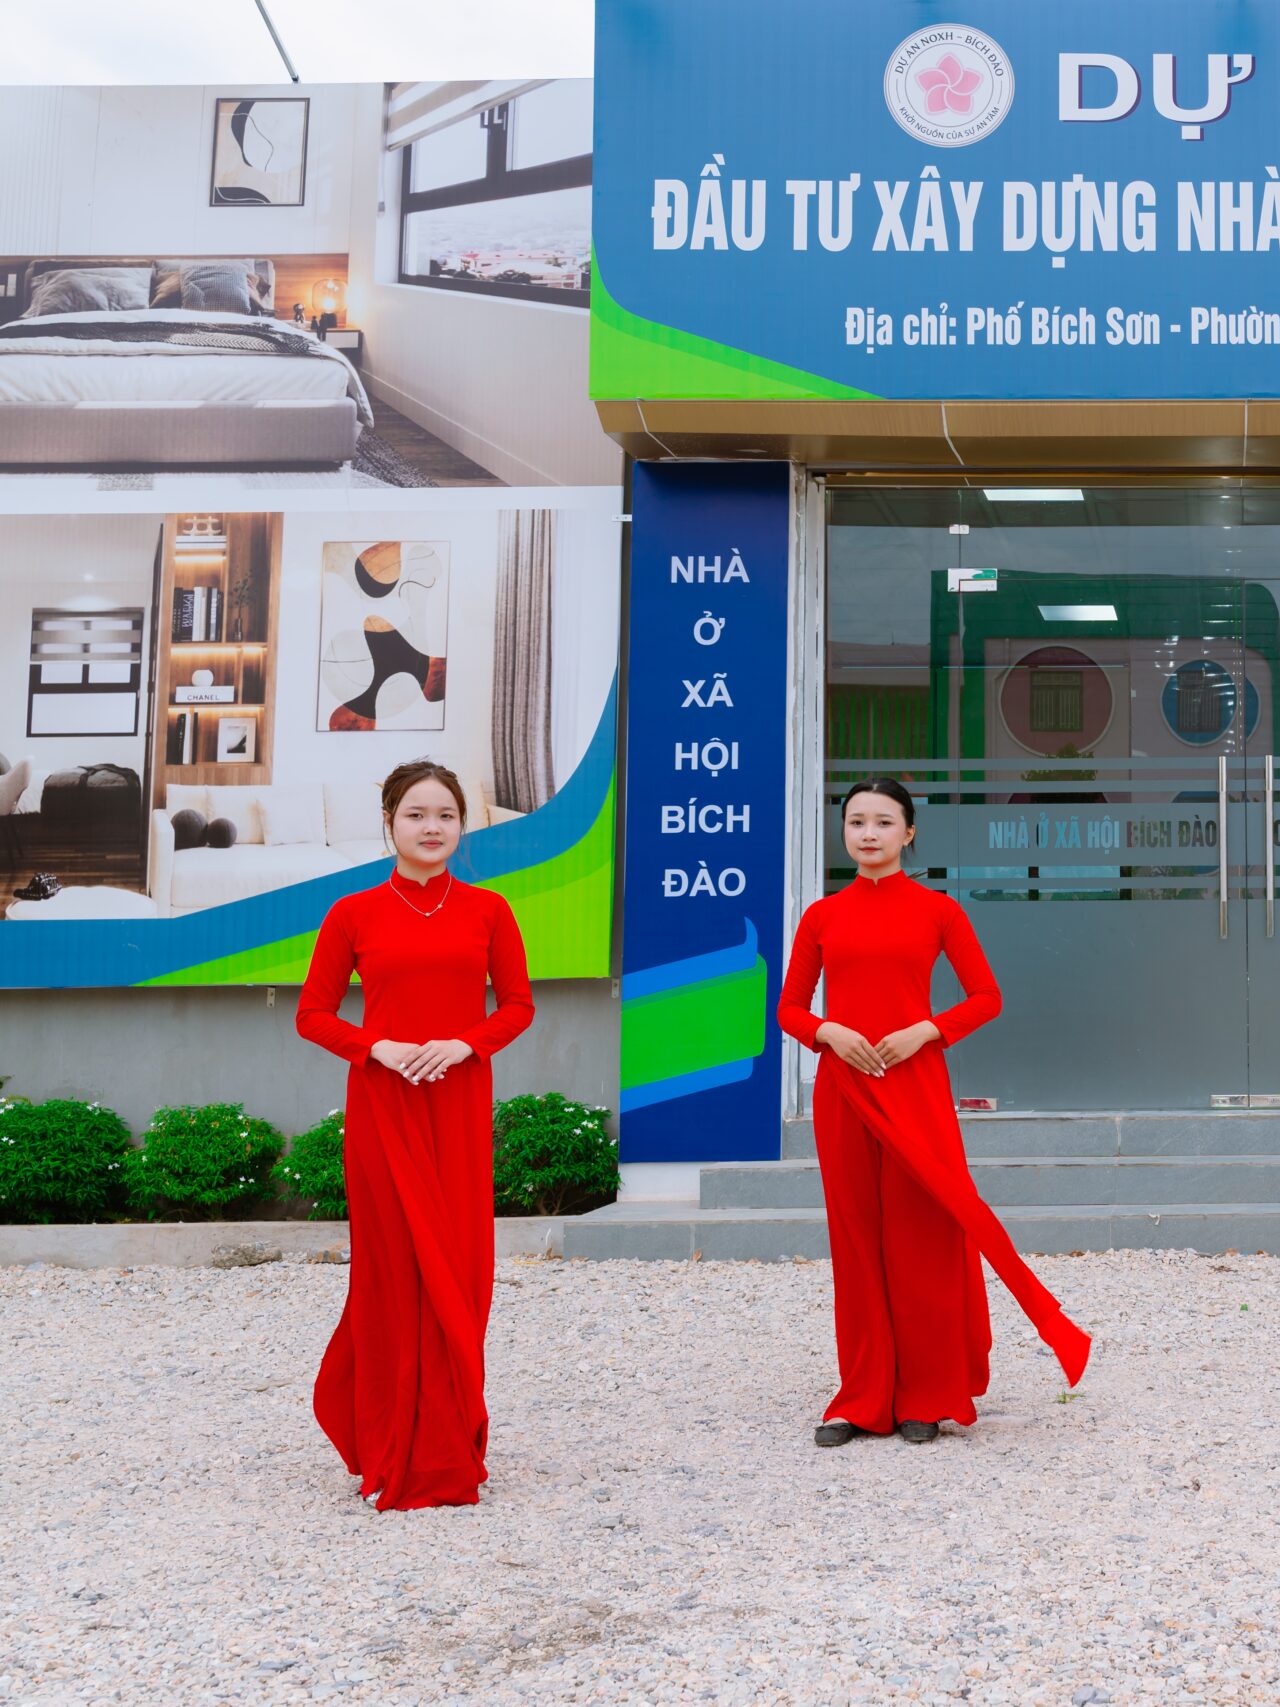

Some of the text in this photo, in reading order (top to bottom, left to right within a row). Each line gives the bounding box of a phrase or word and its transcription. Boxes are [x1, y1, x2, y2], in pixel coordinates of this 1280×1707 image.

[920, 32, 954, 45] NOXH
[964, 35, 991, 55] BÍCH
[987, 53, 1004, 77] ĐÀO
[1058, 52, 1254, 141] DỰ
[976, 120, 988, 131] AN
[651, 153, 767, 252] ĐẦU
[785, 172, 861, 252] TƯ
[872, 165, 984, 252] XÂY
[1002, 173, 1157, 269] DỰNG
[844, 307, 893, 354] Địa
[903, 302, 957, 346] chỉ:
[966, 301, 1025, 346] Phố
[1031, 306, 1096, 345] Bích
[1105, 306, 1161, 346] Sơn
[670, 547, 750, 583] NHÀ
[693, 610, 726, 646] Ở
[681, 672, 734, 708] XÃ
[674, 737, 740, 778] HỘI
[660, 797, 751, 834] BÍCH
[988, 812, 1218, 855] NHÀ Ở XÃ HỘI BÍCH ĐÀO
[661, 860, 746, 897] ĐÀO
